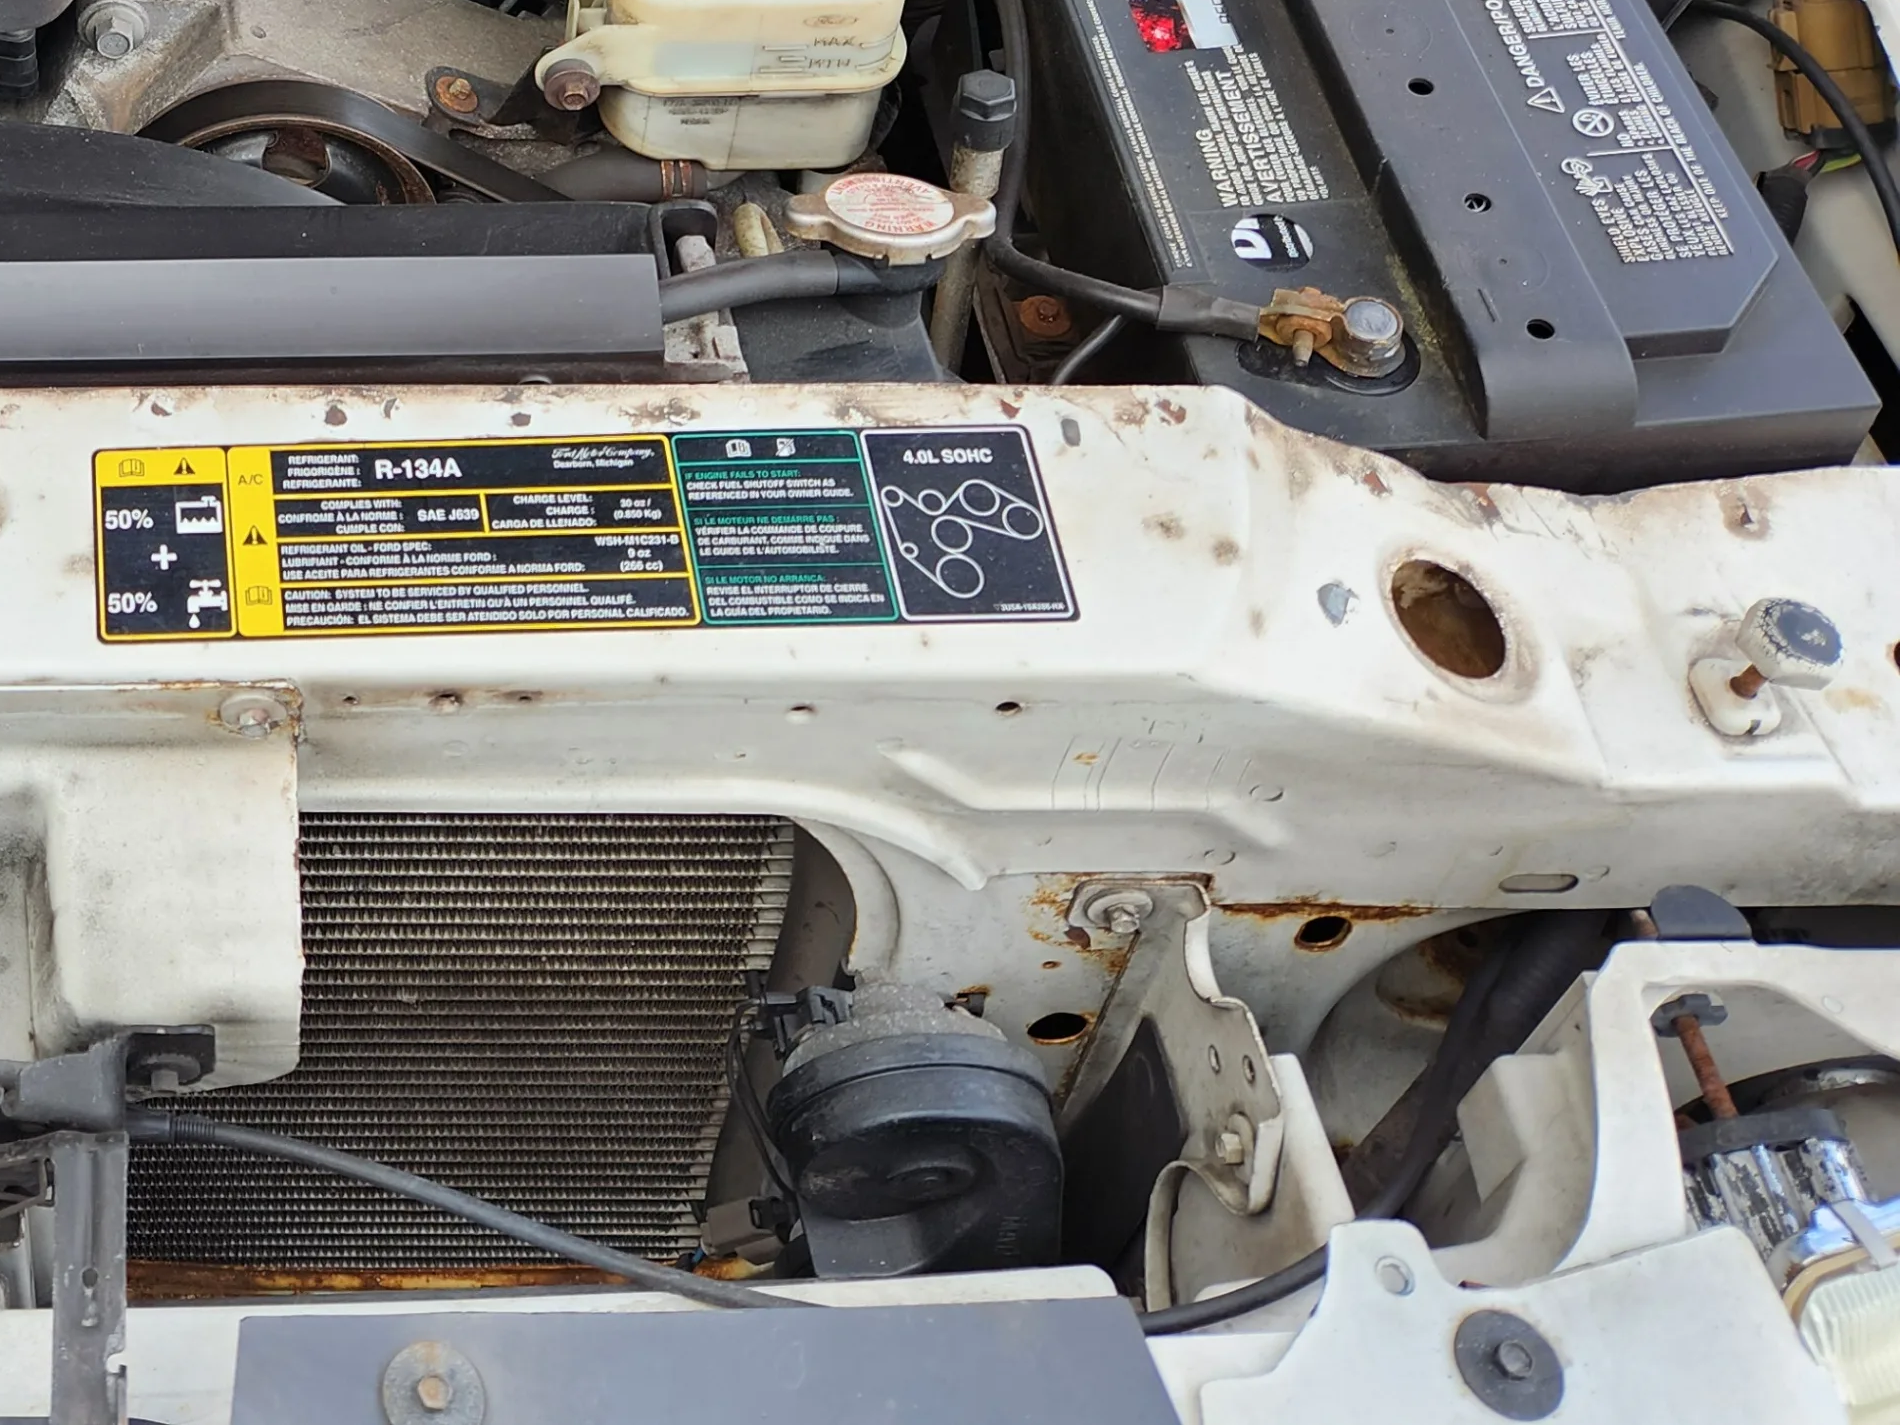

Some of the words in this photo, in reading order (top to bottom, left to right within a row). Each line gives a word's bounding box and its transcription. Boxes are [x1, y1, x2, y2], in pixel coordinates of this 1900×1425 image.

[1216, 70, 1284, 203] AVERTISSEMENT
[1195, 129, 1238, 207] WARNING
[1633, 169, 1654, 187] LES
[1591, 198, 1616, 224] EYES
[1609, 206, 1650, 261] EXPLOSIVE
[1606, 227, 1636, 262] SHIELD
[1635, 227, 1664, 260] GASES
[1674, 245, 1693, 257] SE
[1680, 230, 1706, 256] YEUX
[596, 459, 633, 468] Michigan
[903, 449, 940, 464] 4.0L
[943, 448, 994, 463] SOHC
[288, 454, 359, 465] REFRIGERANT:
[374, 458, 462, 479] R-134A
[238, 474, 264, 485] A/C
[283, 478, 362, 489] REFRIGERANTE:
[720, 480, 742, 489] FUEL
[822, 478, 835, 486] AS
[321, 501, 371, 510] COMPLIES
[373, 499, 401, 509] WITH:
[513, 495, 556, 504] CHARGE
[558, 494, 593, 503] LEVEL:
[346, 511, 360, 521] LA
[417, 509, 446, 521] SAE
[449, 508, 479, 520] J639
[546, 506, 589, 515] CHARGE
[644, 509, 661, 519] Kg)
[105, 509, 154, 529] 50%
[281, 544, 348, 554] REFRIGERANT
[350, 543, 368, 553] OIL
[374, 542, 400, 552] FORD
[402, 541, 432, 551] SPEC:
[285, 590, 332, 600] CAUTION:
[335, 589, 375, 599] SYSTEM
[376, 589, 389, 598] TO
[391, 588, 405, 597] BE
[407, 586, 456, 597] SERVICED
[458, 585, 472, 596] BY
[473, 584, 525, 595] QUALIFIED
[527, 583, 589, 594] PERSONNEL.
[108, 592, 158, 614] 50%
